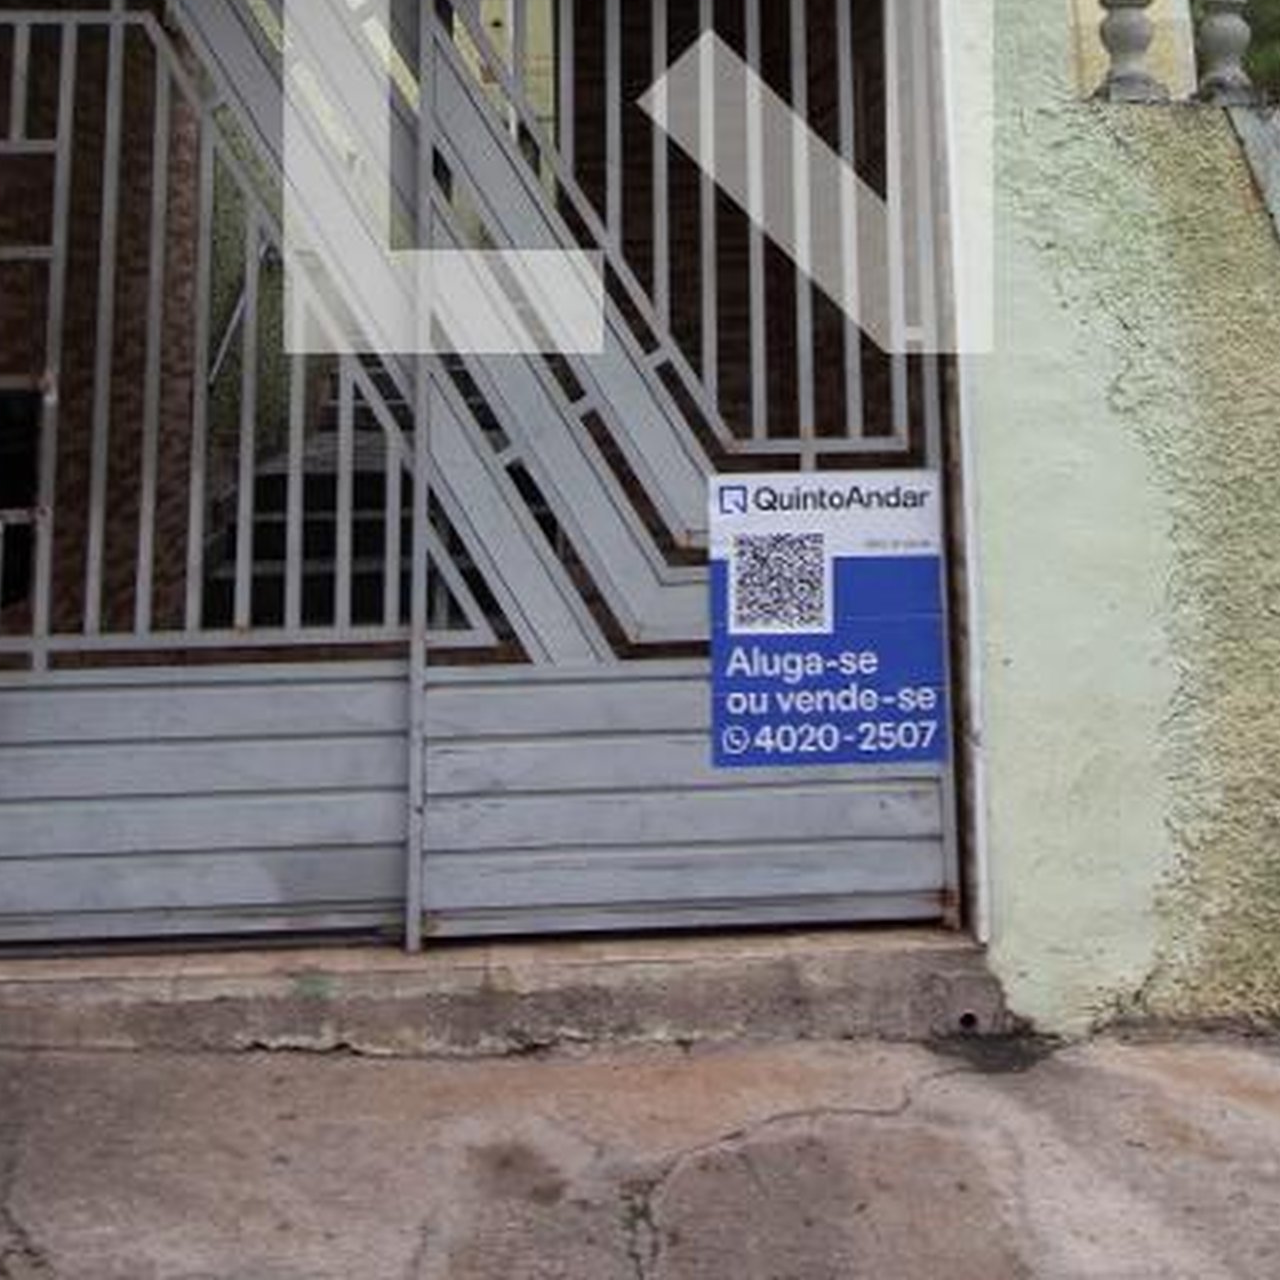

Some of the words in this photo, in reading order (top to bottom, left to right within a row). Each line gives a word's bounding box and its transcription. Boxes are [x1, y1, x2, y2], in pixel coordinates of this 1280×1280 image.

[752, 485, 931, 512] QuintoAndar
[726, 647, 878, 683] Aluga-se
[726, 691, 768, 714] ou
[776, 684, 936, 714] vende-se
[753, 721, 938, 752] 4020-2507
